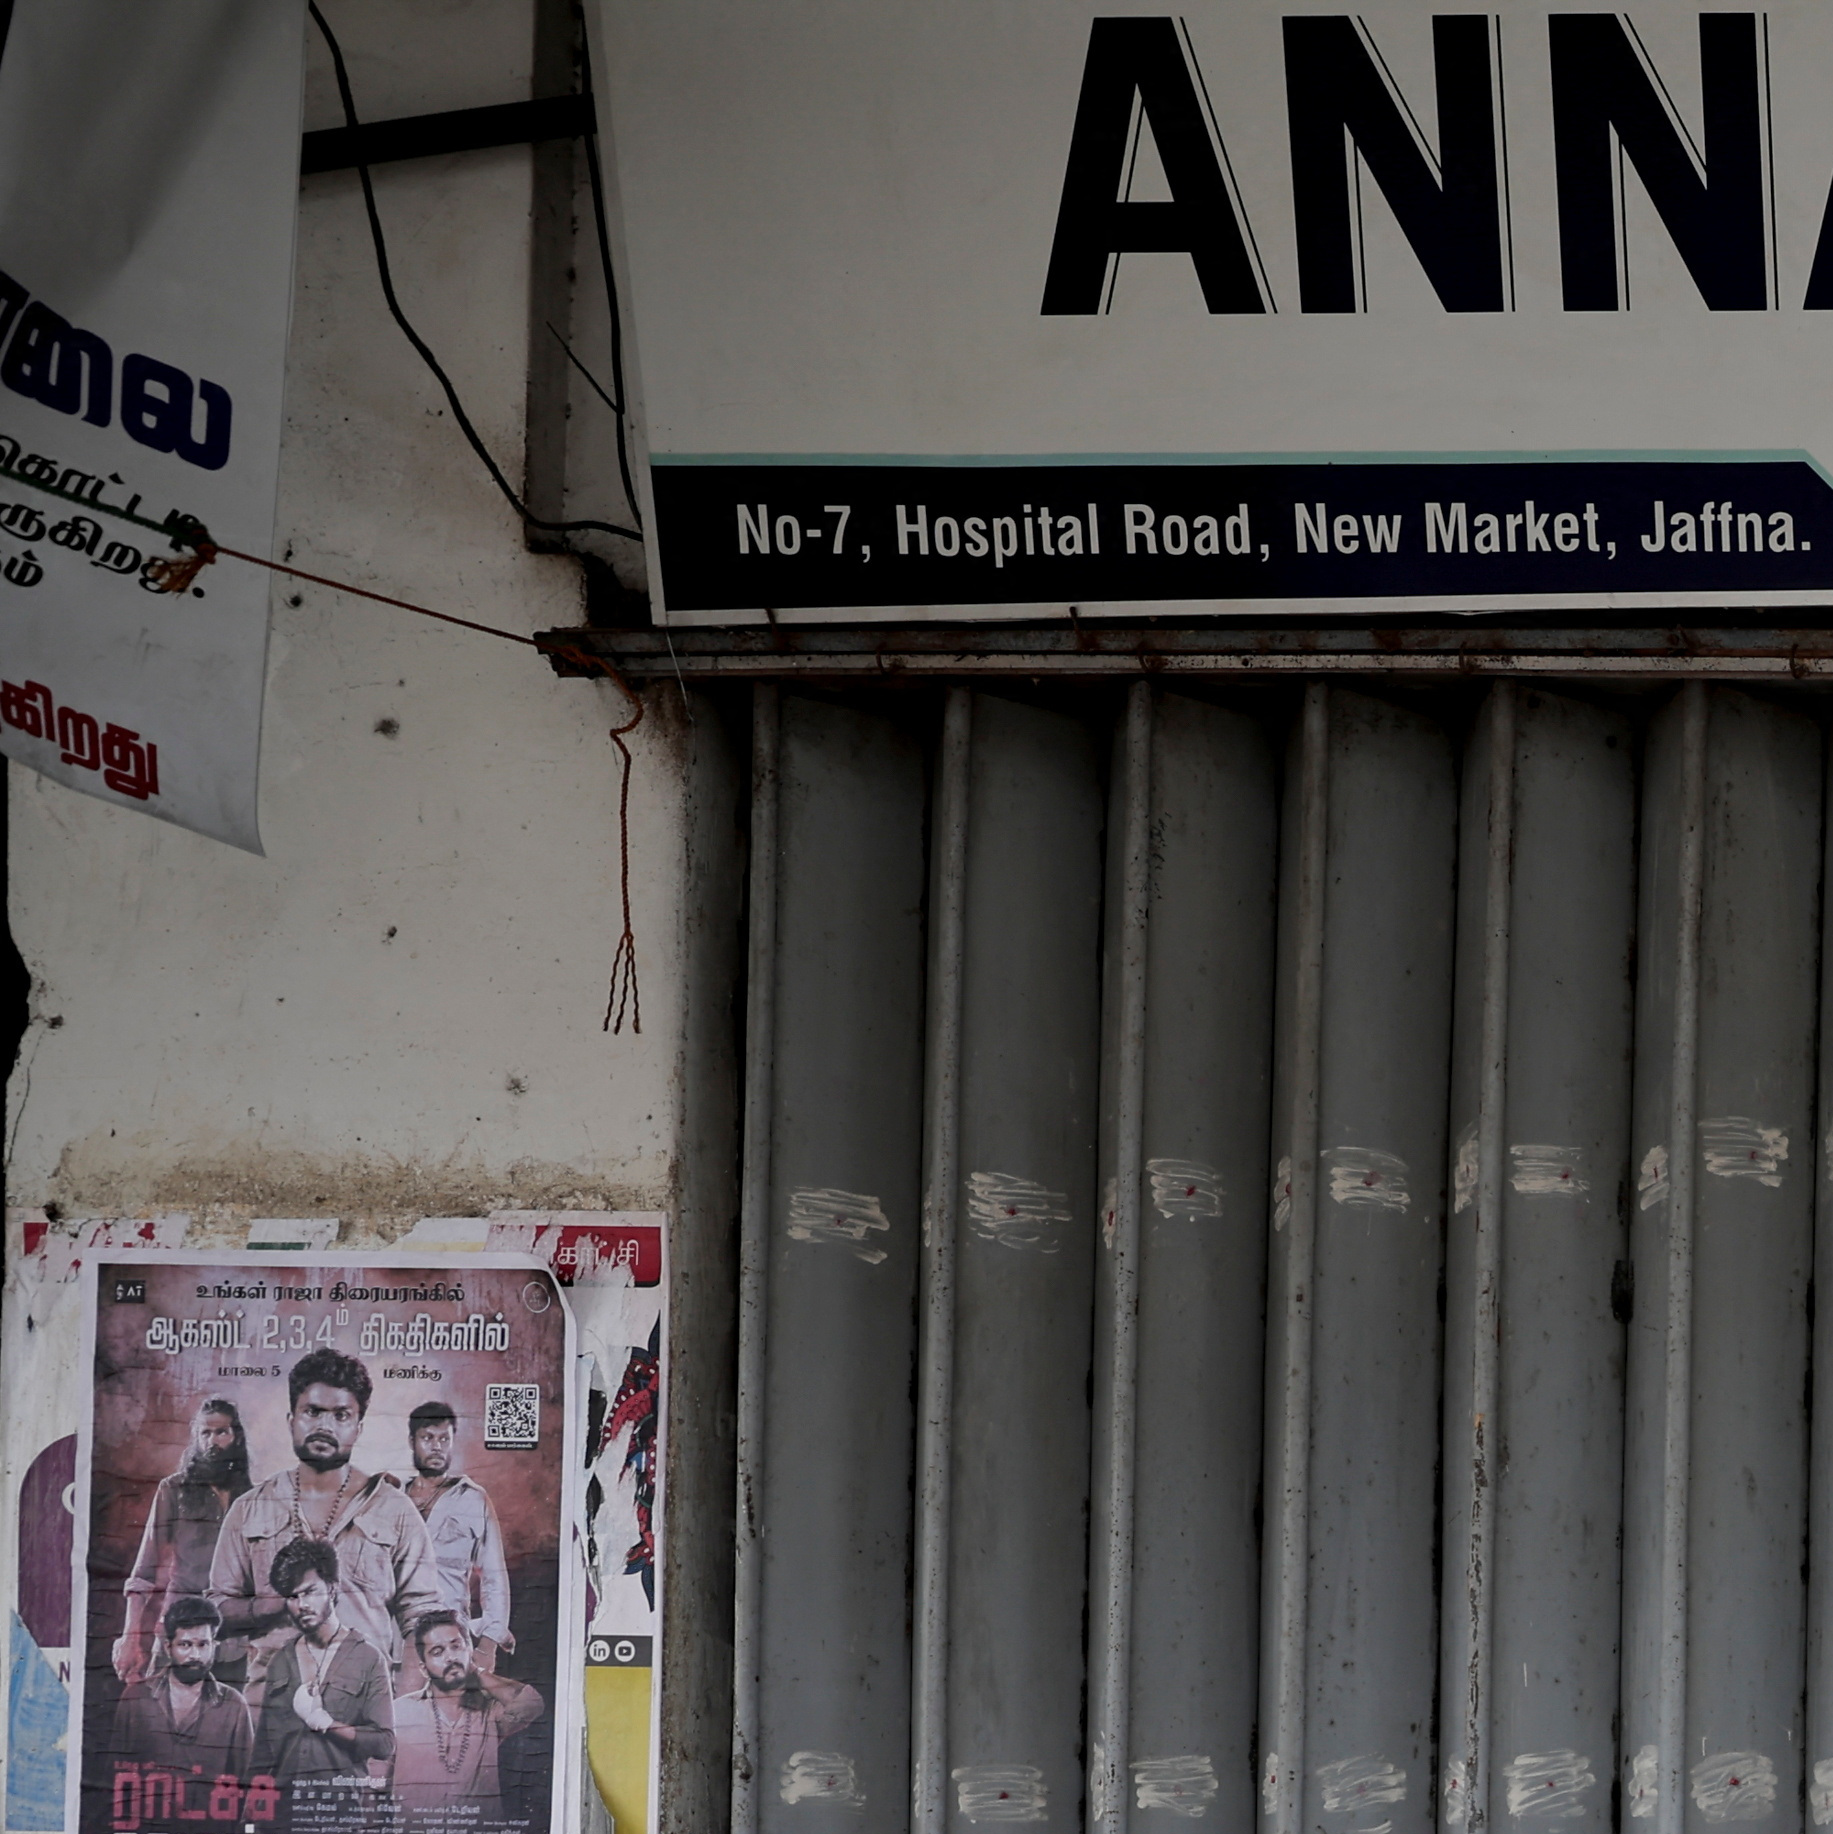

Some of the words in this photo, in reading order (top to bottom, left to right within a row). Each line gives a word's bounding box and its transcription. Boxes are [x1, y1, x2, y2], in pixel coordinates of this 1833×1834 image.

[736, 501, 872, 564] No-7,
[895, 500, 1101, 568] Hospital
[1125, 498, 1270, 562] Road,
[1295, 499, 1403, 557] New
[1425, 498, 1618, 561] Market,
[1640, 496, 1812, 553] Jaffna.
[196, 1281, 264, 1301] உங்கள்
[274, 1283, 322, 1302] ராஜா
[329, 1281, 466, 1303] திரையரங்கில்
[146, 1307, 252, 1355] ஆகஸ்ட்
[358, 1307, 510, 1356] திகதிகளில்
[218, 1366, 268, 1378] மாலை
[271, 1366, 281, 1378] 5
[383, 1366, 444, 1382] மணிக்கு
